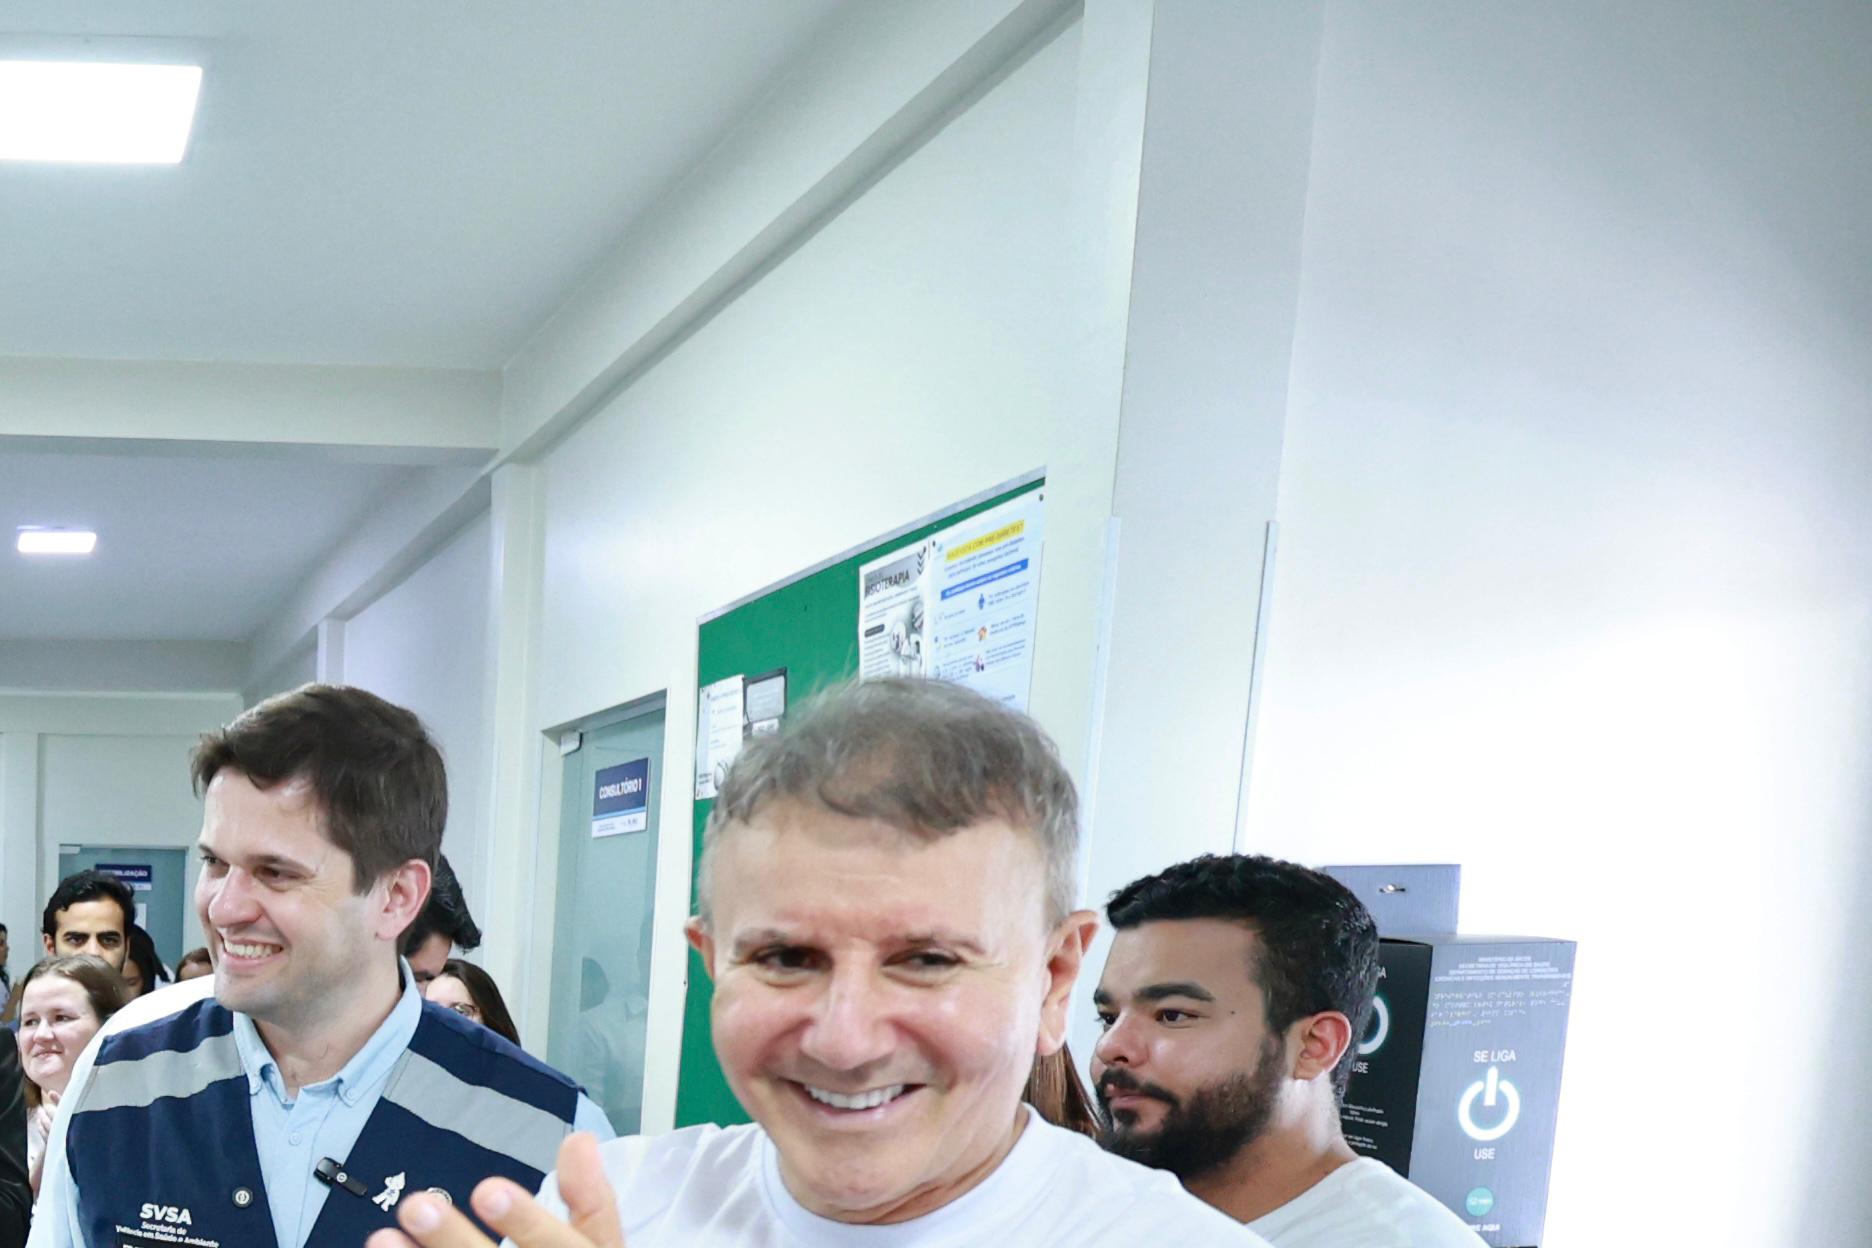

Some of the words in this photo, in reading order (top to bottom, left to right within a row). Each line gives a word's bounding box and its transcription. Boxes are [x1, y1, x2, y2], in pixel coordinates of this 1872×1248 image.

[1473, 1051, 1489, 1063] SE
[1490, 1049, 1517, 1063] LIGA
[1352, 1062, 1369, 1074] USE
[1473, 1148, 1495, 1160] USE
[140, 1202, 192, 1226] SVSA
